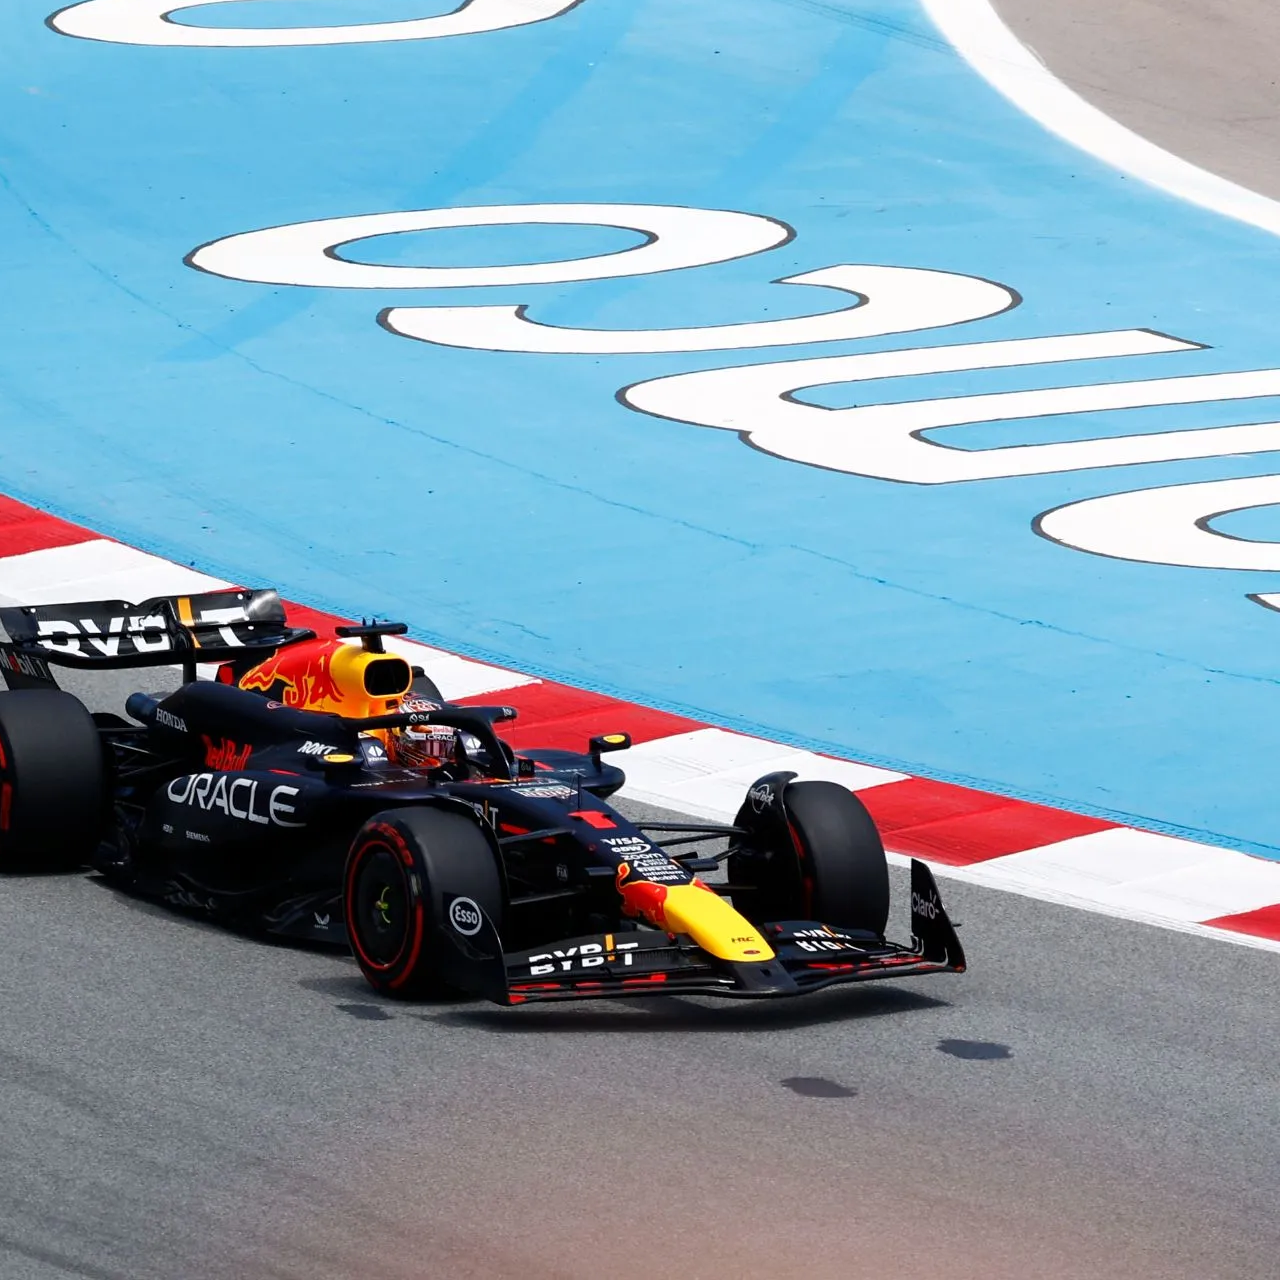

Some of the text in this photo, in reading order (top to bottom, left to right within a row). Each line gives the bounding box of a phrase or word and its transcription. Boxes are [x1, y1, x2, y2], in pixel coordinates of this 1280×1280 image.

[184, 203, 1280, 614] mco
[156, 708, 188, 732] HONDA
[167, 773, 308, 828] ORACLE
[600, 836, 645, 845] VISA
[454, 905, 478, 925] Esso
[528, 934, 639, 976] BYBIT
